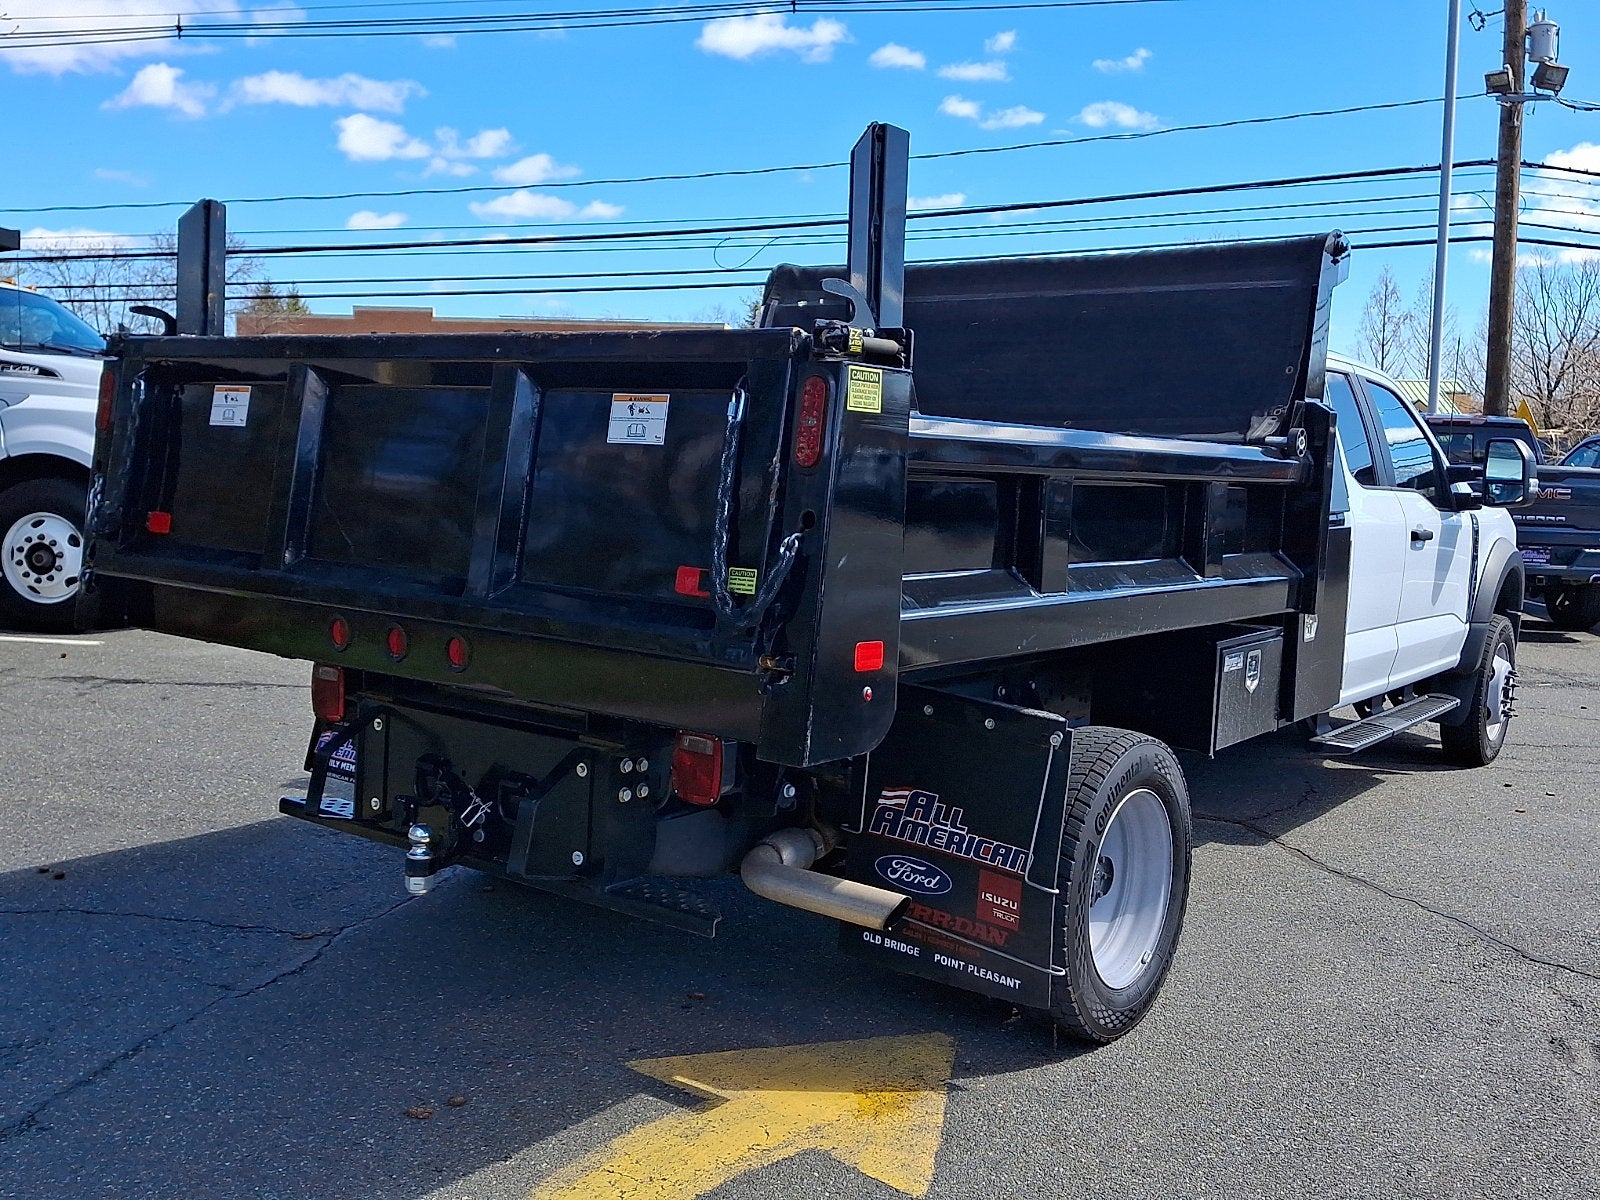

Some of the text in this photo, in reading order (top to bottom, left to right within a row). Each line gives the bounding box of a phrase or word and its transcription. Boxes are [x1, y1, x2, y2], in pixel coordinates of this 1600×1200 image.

[851, 370, 879, 382] CAUTION
[1534, 488, 1571, 500] MC
[1094, 756, 1143, 836] Continental
[903, 789, 968, 834] ALL
[869, 805, 1030, 875] AMERICAN
[887, 859, 941, 889] Ford
[981, 891, 1018, 910] ISUZU
[992, 910, 1016, 923] TRUCK
[863, 932, 882, 945] OLD
[884, 937, 921, 957] BRIDGE
[934, 953, 1021, 990] POINT PLEASANT
